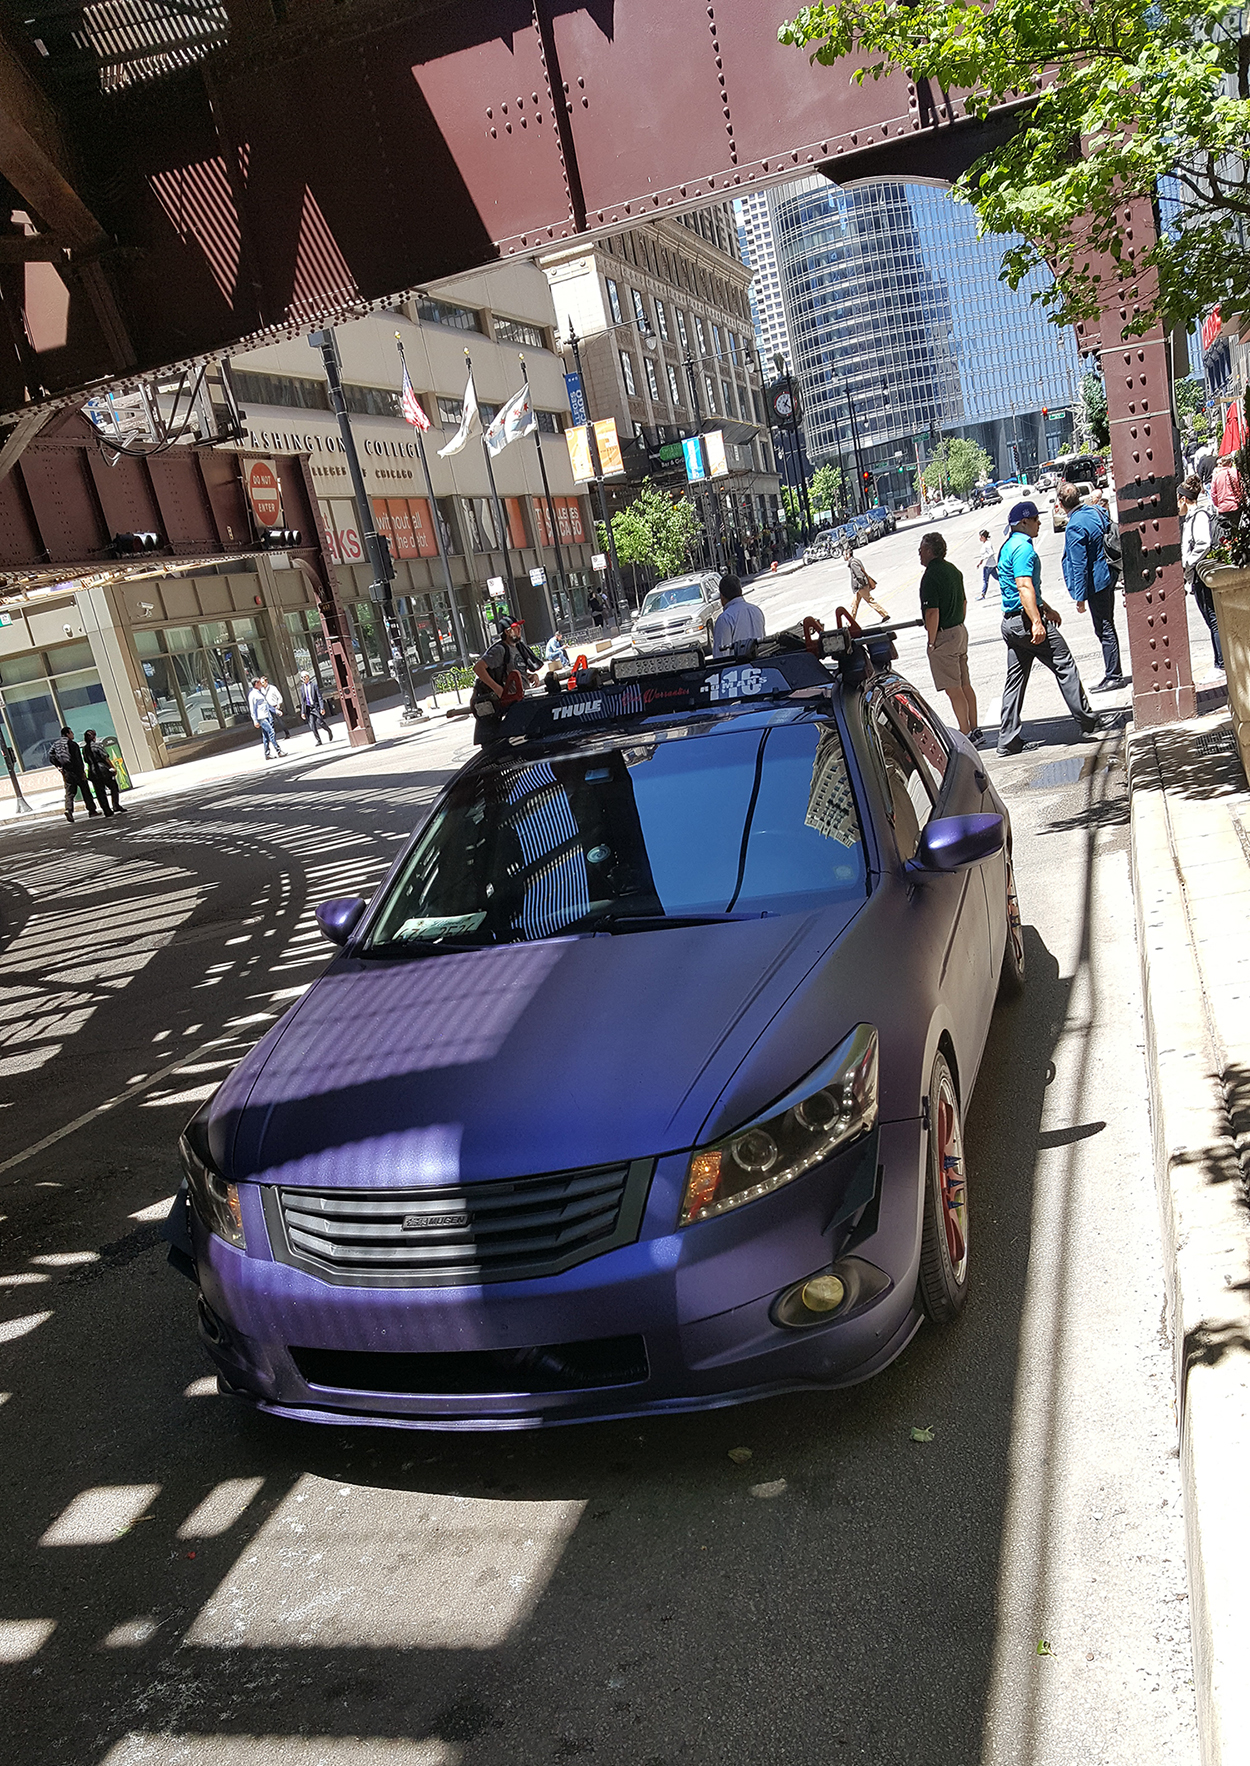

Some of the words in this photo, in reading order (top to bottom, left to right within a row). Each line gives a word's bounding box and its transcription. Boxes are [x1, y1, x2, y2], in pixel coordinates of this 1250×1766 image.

[312, 466, 347, 477] LLEGES
[375, 469, 413, 479] CHICAGO
[252, 475, 261, 485] DO
[261, 475, 272, 485] NOT
[258, 503, 276, 513] ENTER
[551, 699, 602, 720] THULE
[428, 1216, 466, 1226] MUGEN
